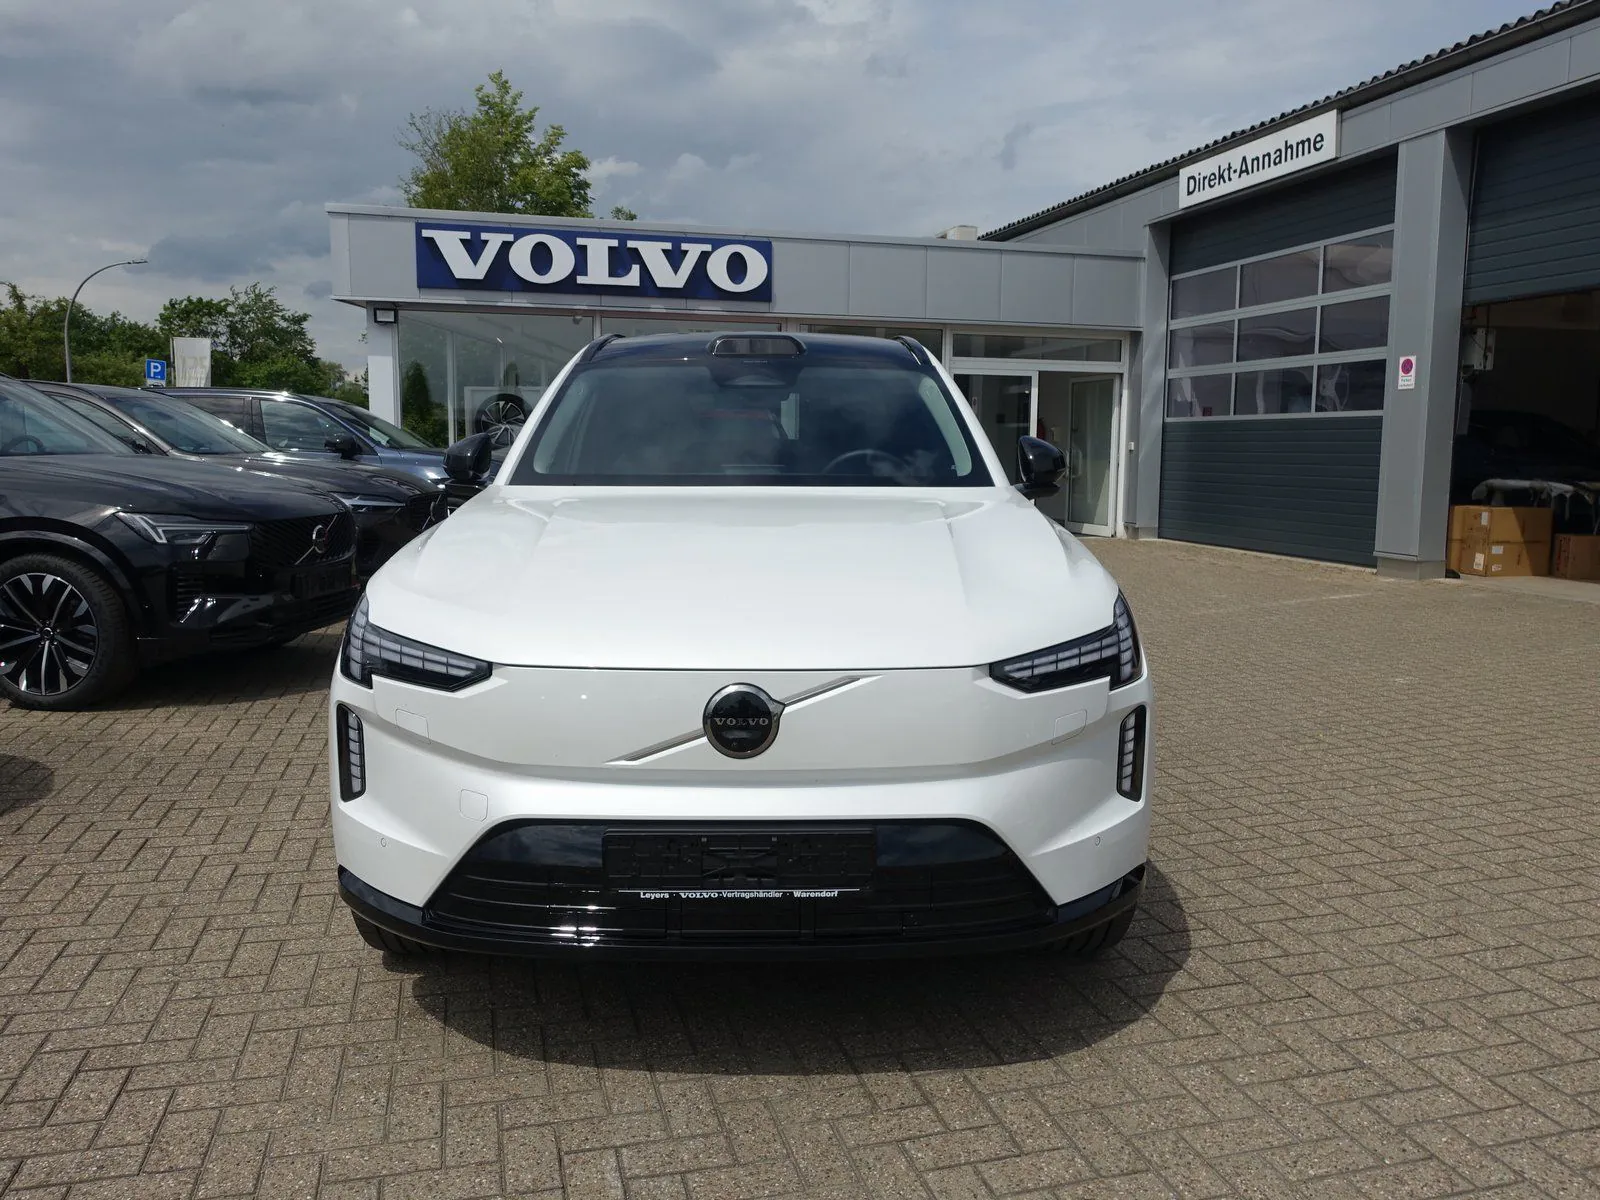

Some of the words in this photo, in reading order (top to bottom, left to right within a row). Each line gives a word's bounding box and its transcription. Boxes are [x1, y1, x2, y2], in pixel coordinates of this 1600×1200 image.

[1186, 133, 1325, 196] Direkt-Annahme
[421, 229, 768, 293] VOLVO
[150, 362, 162, 378] P
[714, 718, 769, 726] VOLVO
[640, 891, 670, 900] Leyers
[793, 889, 839, 898] Warendorf
